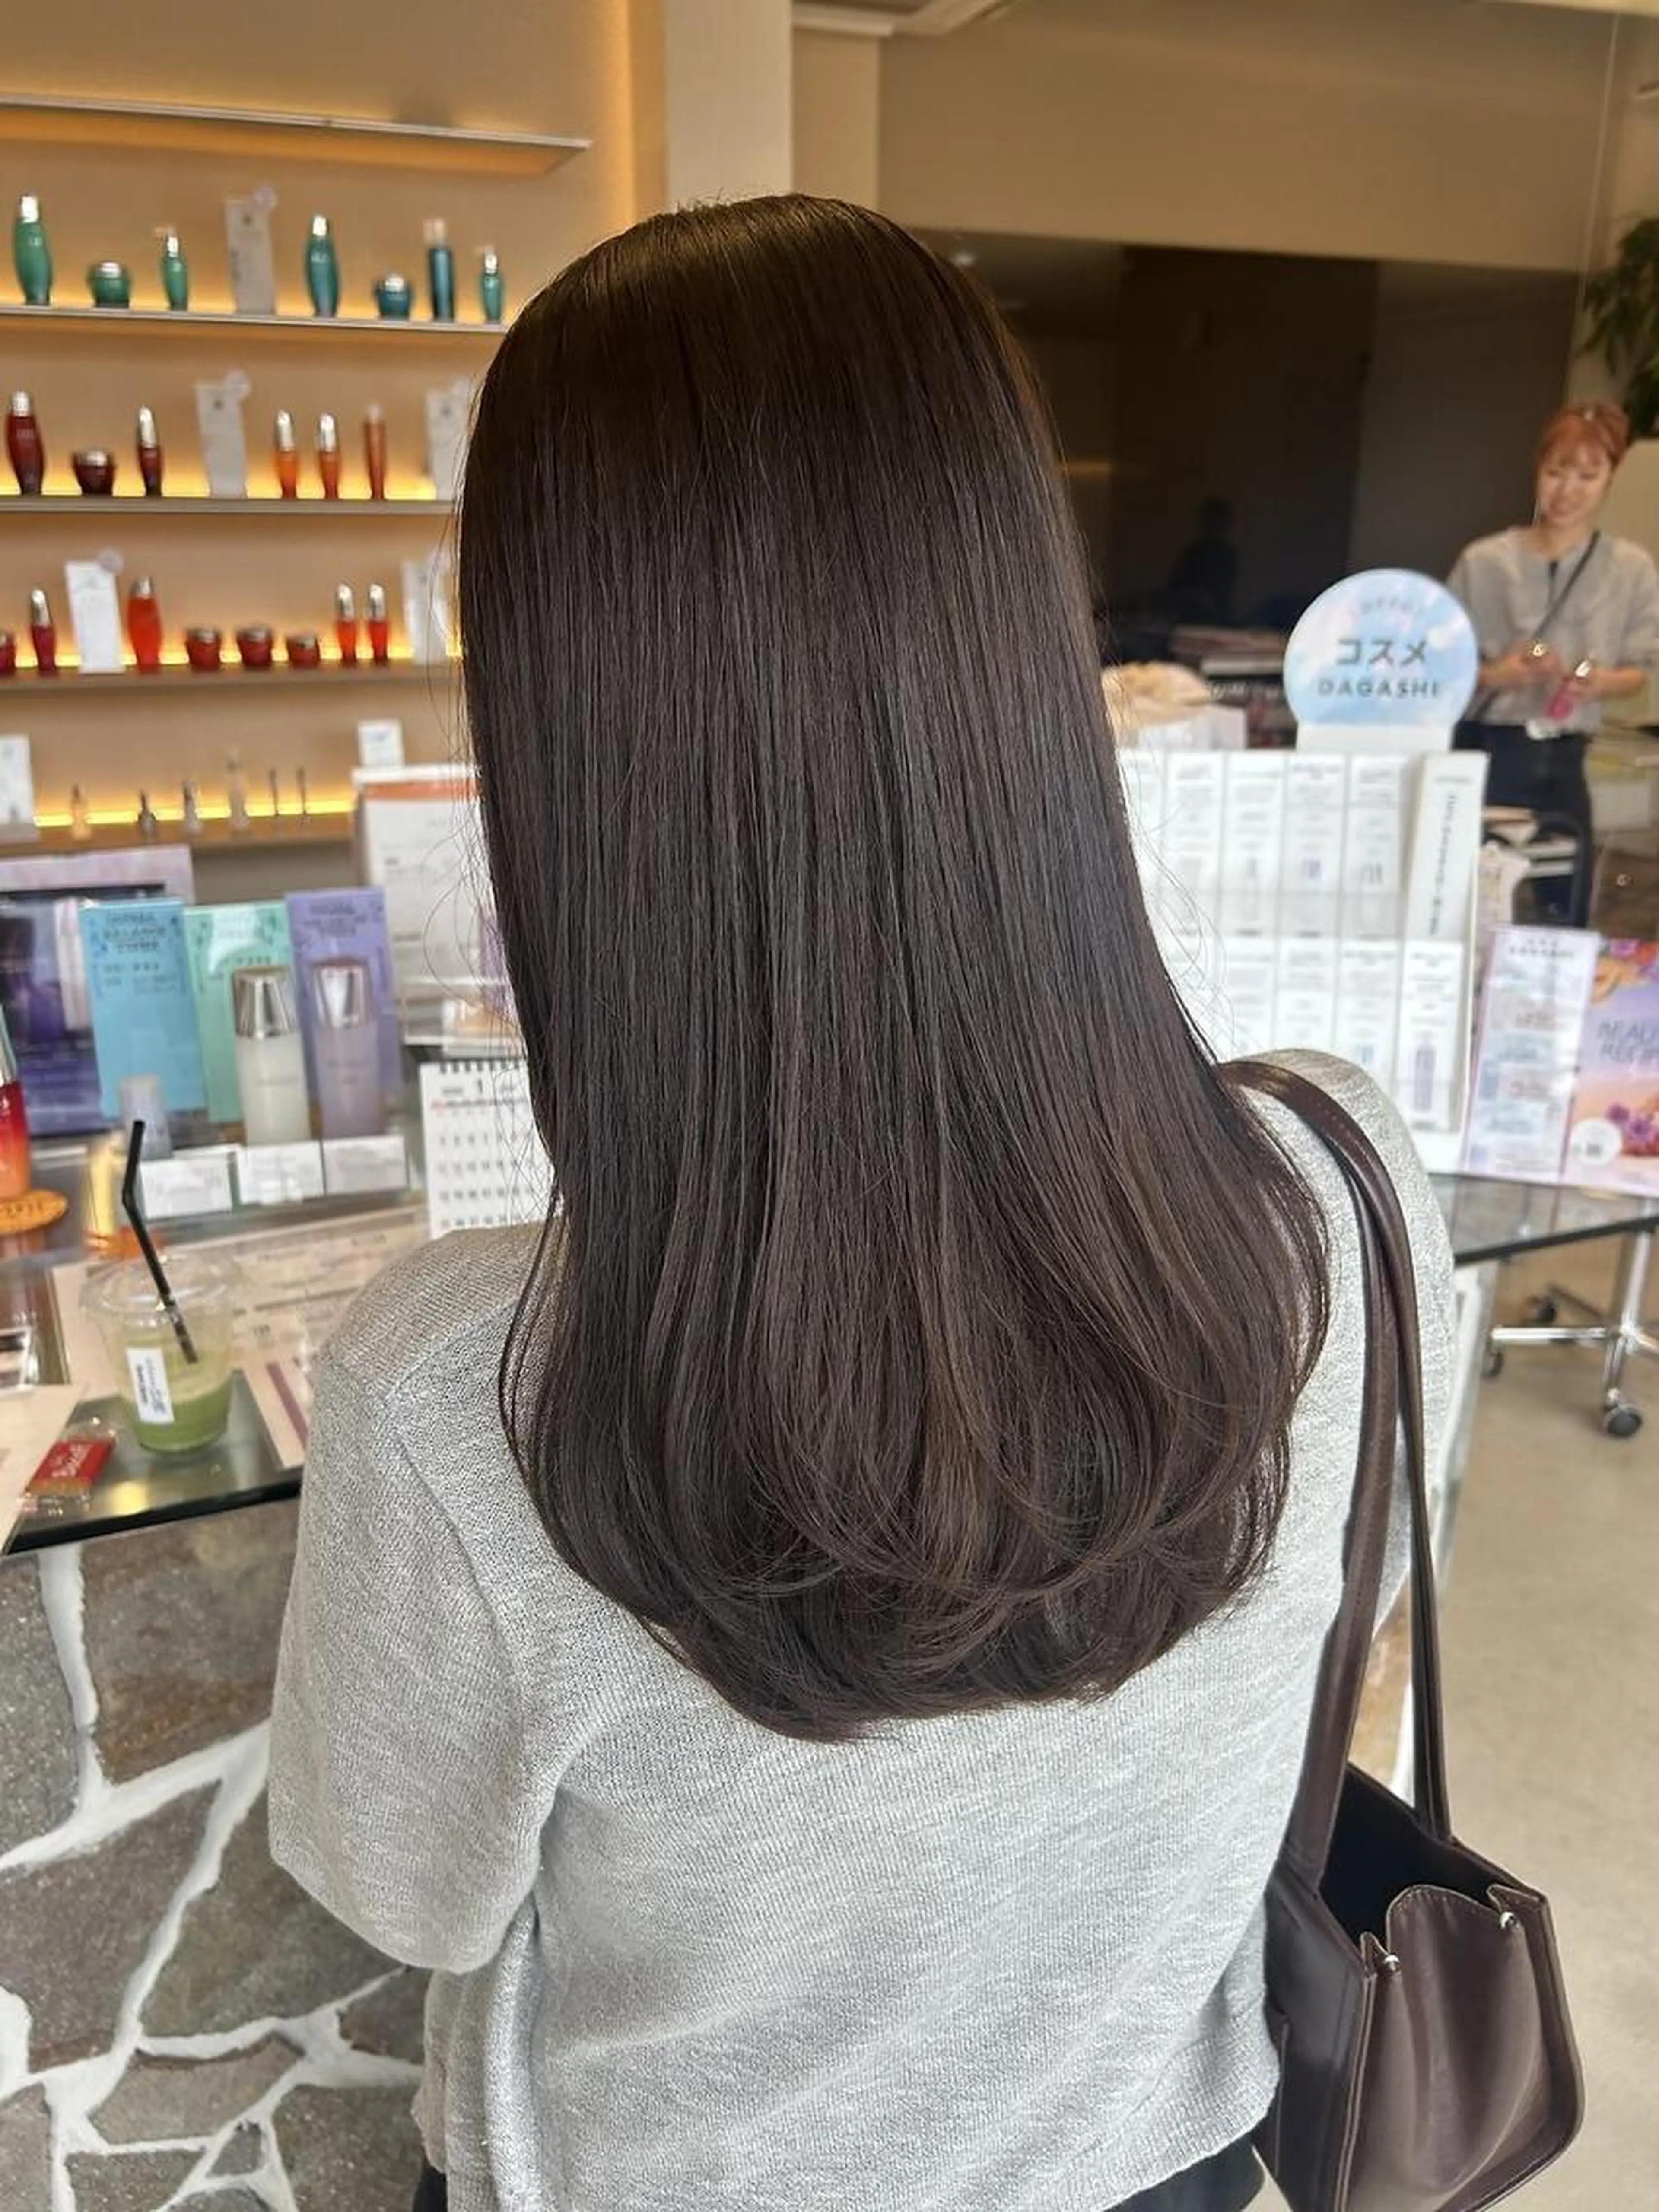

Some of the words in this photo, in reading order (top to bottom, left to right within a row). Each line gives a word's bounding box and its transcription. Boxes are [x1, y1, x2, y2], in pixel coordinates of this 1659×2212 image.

[1336, 638, 1427, 666] コスメ
[1318, 678, 1438, 699] DAGASHI
